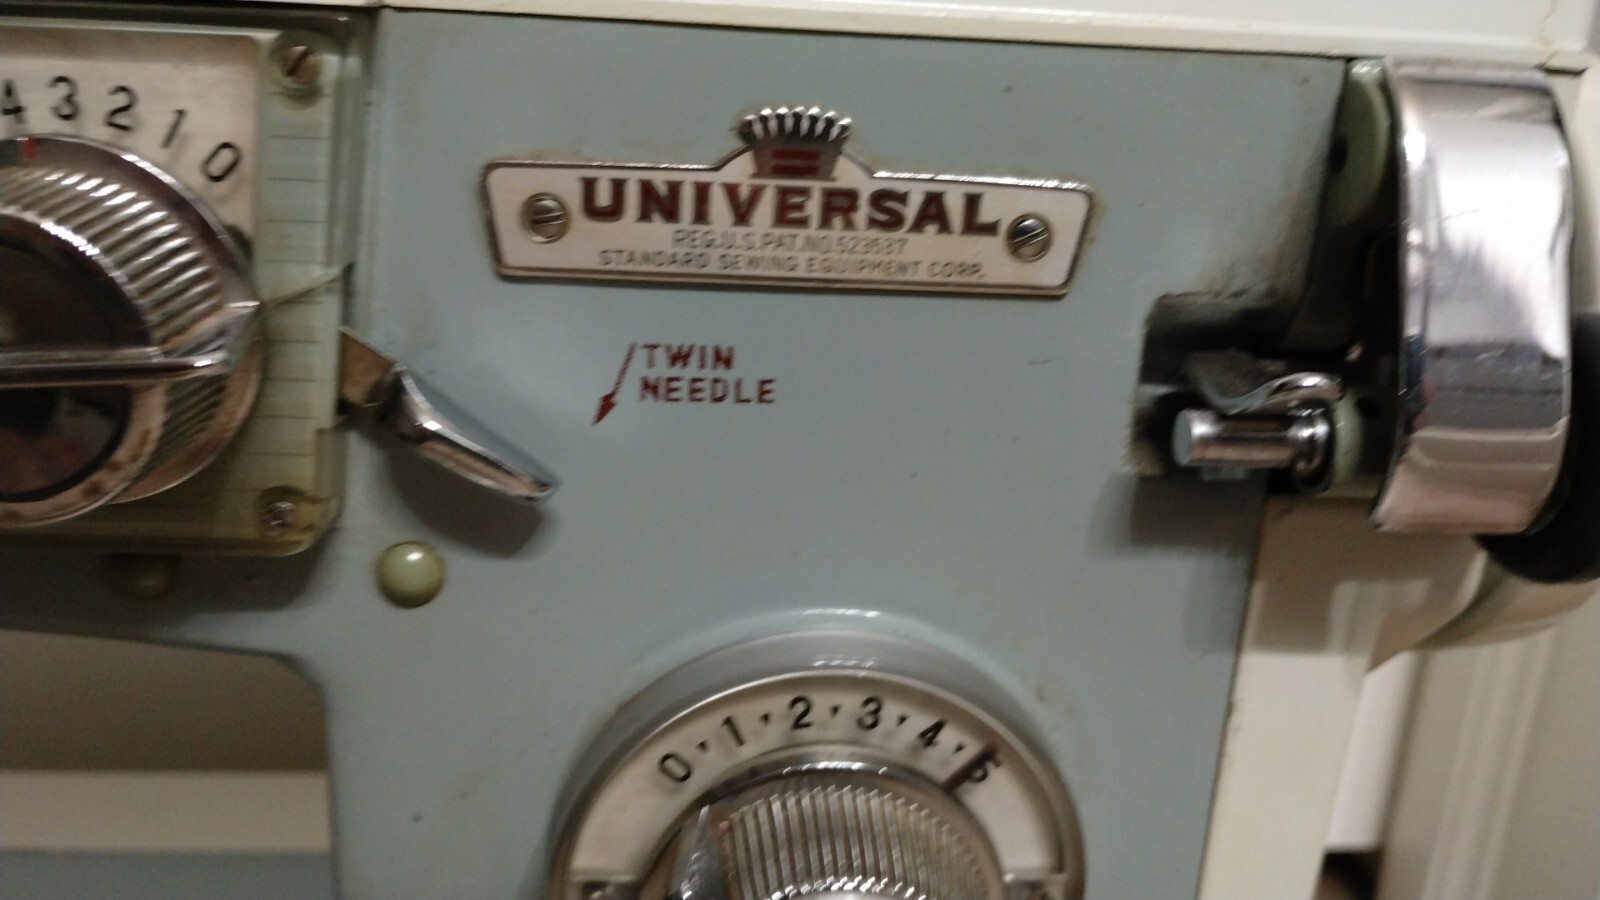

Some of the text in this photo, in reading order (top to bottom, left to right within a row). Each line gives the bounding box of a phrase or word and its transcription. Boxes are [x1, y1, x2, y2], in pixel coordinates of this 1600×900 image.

[50, 75, 79, 121] 3
[105, 85, 138, 132] 2
[161, 108, 188, 149] 1
[201, 142, 242, 183] 0
[579, 177, 999, 237] UNIVERSAL
[599, 250, 711, 271] STANDARD
[718, 253, 799, 274] SEWING
[805, 256, 922, 278] EQUIPMENT
[641, 343, 736, 371] TWIN
[639, 375, 777, 405] NEEDLE
[659, 696, 1003, 783] 0 1 2 3 4 5
